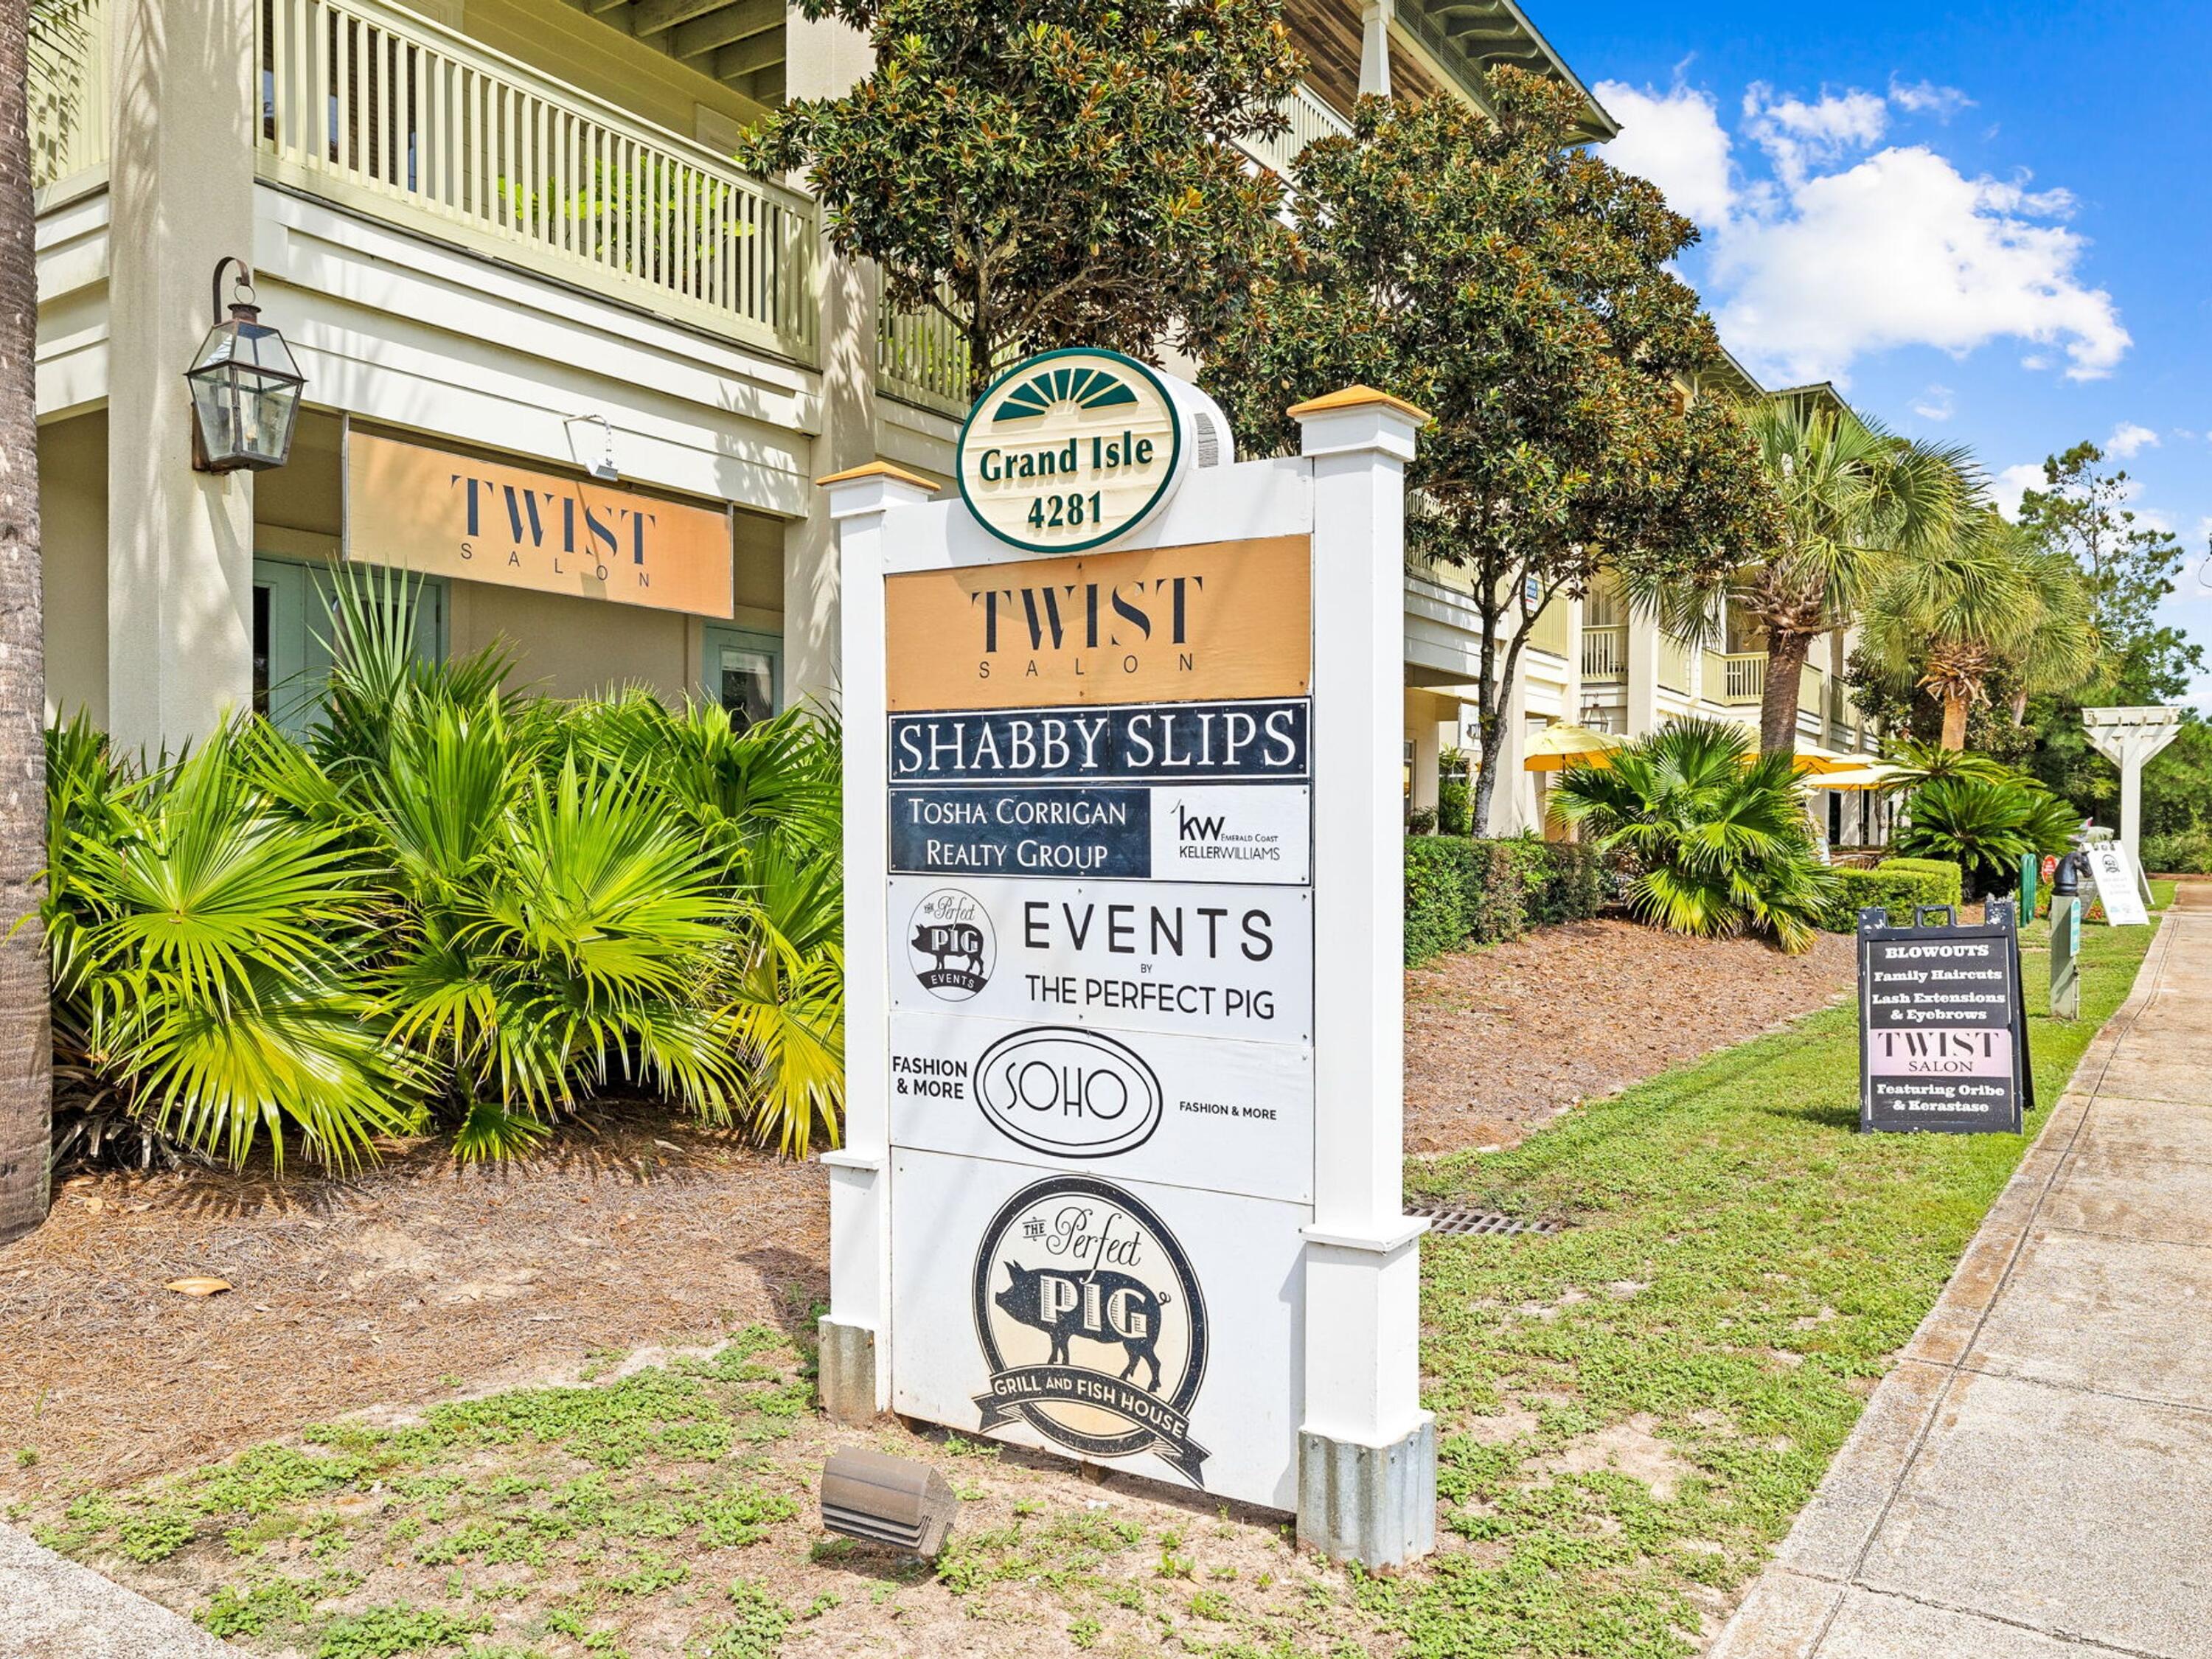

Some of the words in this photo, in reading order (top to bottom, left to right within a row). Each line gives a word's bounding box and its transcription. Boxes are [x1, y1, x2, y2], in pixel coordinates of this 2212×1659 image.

[980, 438, 1077, 482] Grand
[1093, 431, 1153, 469] Isle
[451, 475, 655, 565] TWIST
[1028, 492, 1102, 529] 4281
[461, 543, 650, 588] SALON
[972, 577, 1203, 653] TWIST
[979, 653, 1193, 678] SALON
[899, 717, 1107, 773] SHABBY
[1126, 710, 1296, 768] SLIPS
[908, 798, 987, 824] TOSHA
[996, 796, 1126, 824] CORRIGAN
[1180, 805, 1225, 841] kw
[927, 841, 1007, 867] REALTY
[1017, 841, 1107, 869] GROUP
[1180, 846, 1280, 860] KELLERWILLIAMS
[934, 896, 975, 931] Perfect
[931, 928, 978, 953] PIG
[1024, 901, 1273, 961] EVENTS
[1885, 945, 1989, 959] BLOWOUTS
[931, 973, 975, 989] EVENTS
[1141, 964, 1152, 973] BY
[1874, 971, 1928, 983] Family
[1930, 970, 2003, 981] Haircuts
[1025, 974, 1077, 1004] THE
[1086, 978, 1216, 1014] PERFECT
[1225, 991, 1274, 1019] PIG
[1872, 994, 1910, 1004] Lash
[1913, 992, 2006, 1004] Extensions
[1891, 1009, 1904, 1020] &
[1906, 1009, 1987, 1023] Eyebrows
[1877, 1032, 1999, 1057] TWIST
[892, 1056, 967, 1078] FASHION
[1908, 1060, 1973, 1073] SALON
[897, 1079, 908, 1094] &
[913, 1081, 964, 1099] MORE
[1005, 1061, 1127, 1120] SOHO
[1877, 1084, 1955, 1098] Featuring
[1958, 1085, 2005, 1096] Oribe
[1180, 1101, 1228, 1115] FASHION
[1231, 1106, 1239, 1116] &
[1242, 1108, 1276, 1120] MORE
[1892, 1100, 1905, 1111] &
[1908, 1099, 1989, 1112] Kerastase
[1024, 1221, 1045, 1236] THE
[1046, 1206, 1141, 1284] Perfect
[1040, 1275, 1148, 1338] PIG
[994, 1376, 1041, 1397] GRILL
[1046, 1378, 1072, 1392] AND
[1077, 1380, 1116, 1405] FISH
[1121, 1394, 1186, 1437] HOUSE
